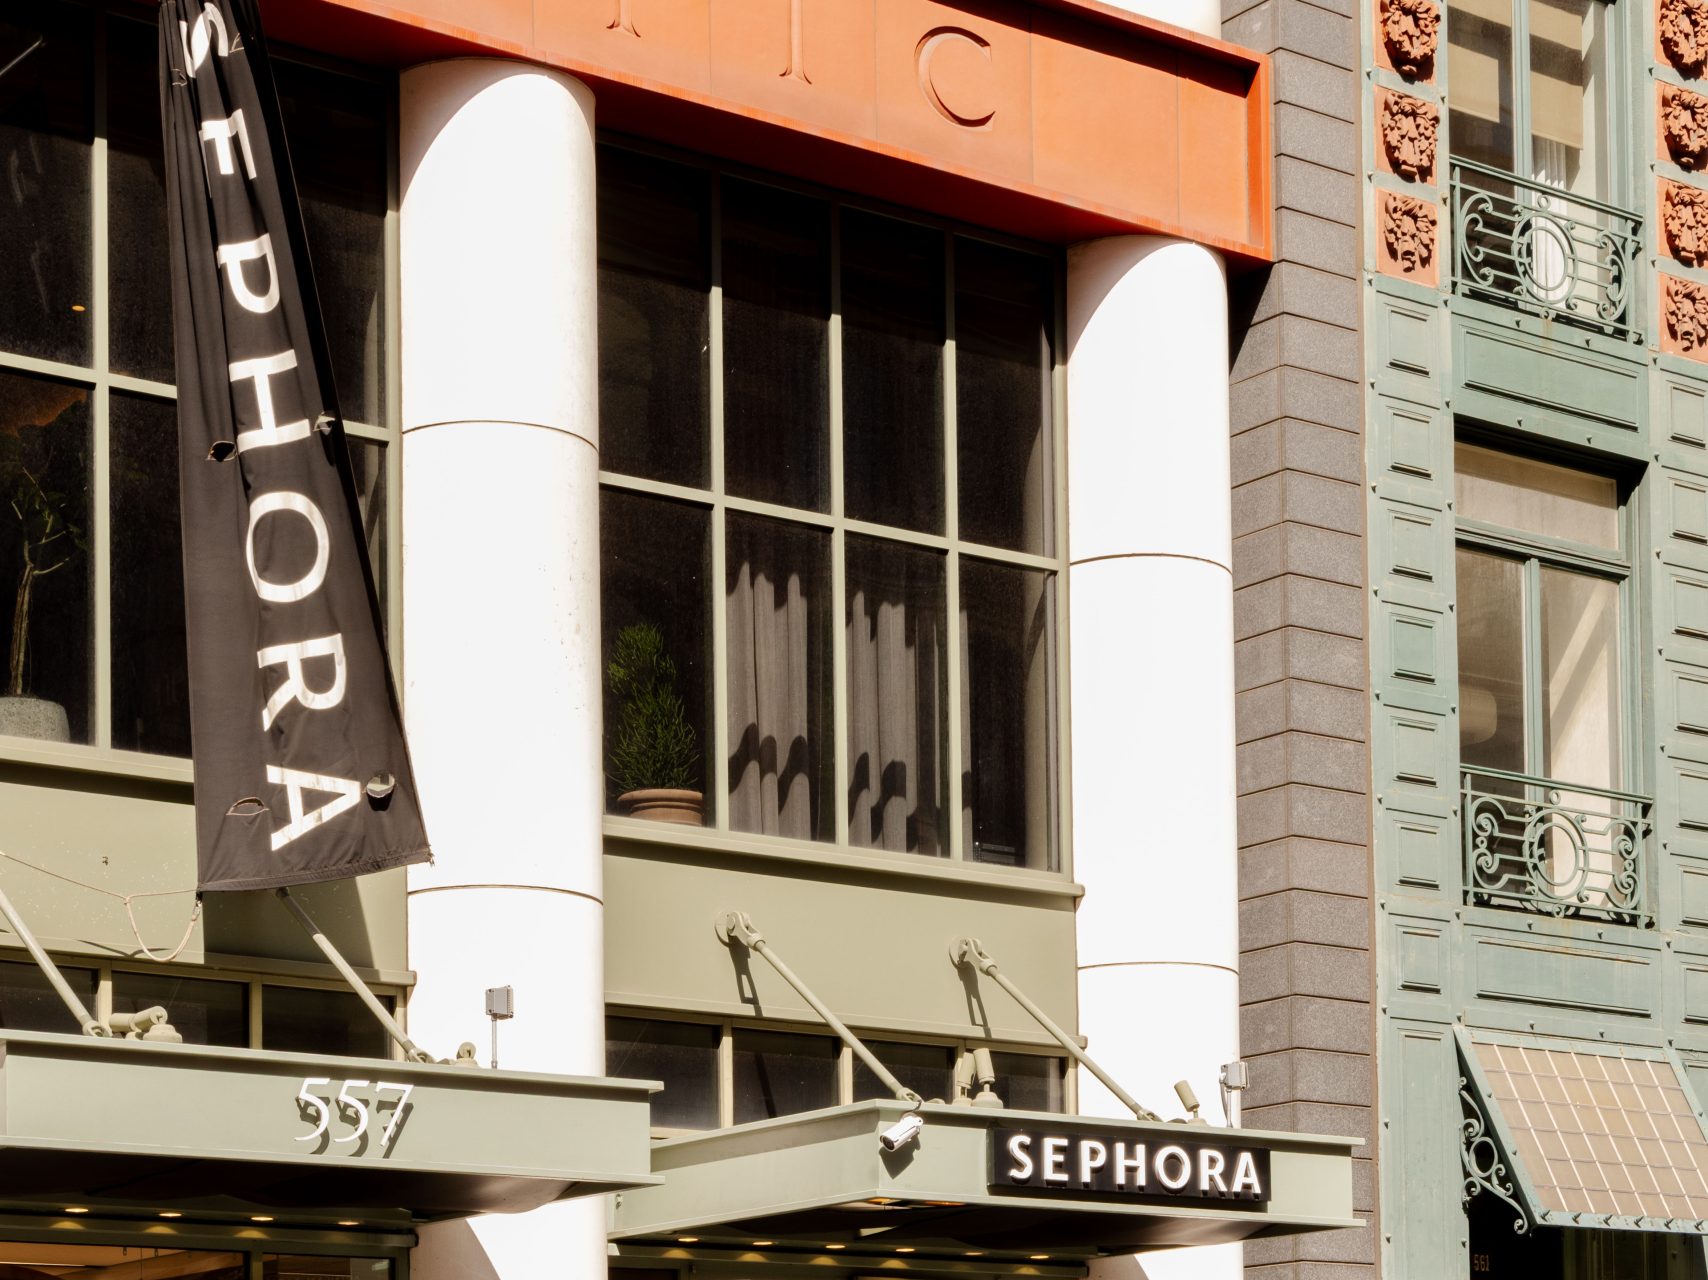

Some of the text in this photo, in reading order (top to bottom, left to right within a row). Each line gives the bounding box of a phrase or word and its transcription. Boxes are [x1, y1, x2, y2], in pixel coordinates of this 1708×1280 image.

[178, 7, 364, 852] SEPHORA
[294, 1077, 415, 1147] 557
[1007, 1134, 1262, 1195] SEPHORA
[1473, 1253, 1490, 1272] 561
